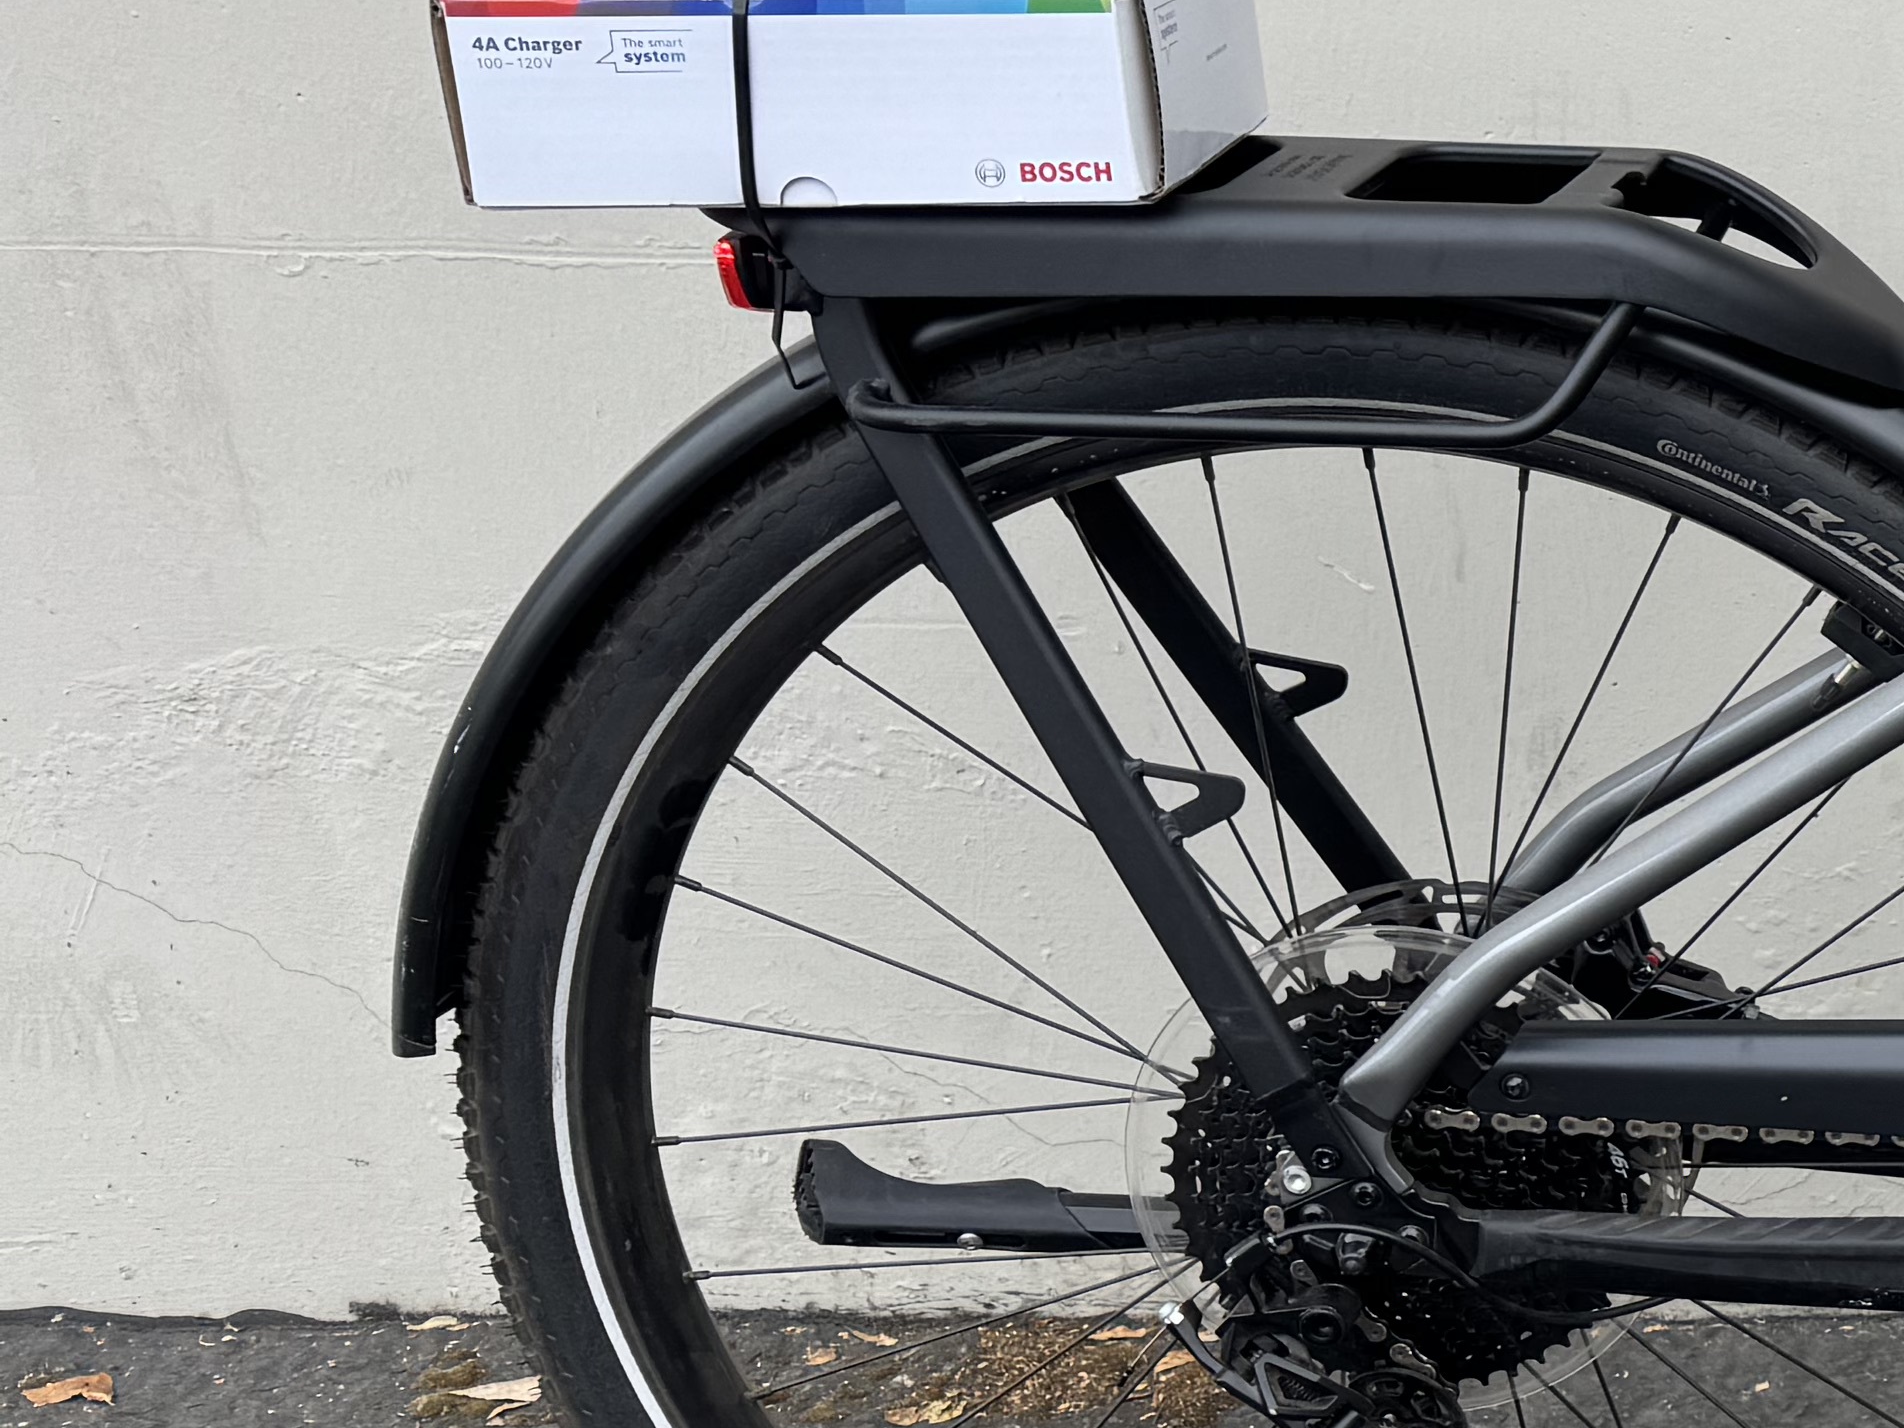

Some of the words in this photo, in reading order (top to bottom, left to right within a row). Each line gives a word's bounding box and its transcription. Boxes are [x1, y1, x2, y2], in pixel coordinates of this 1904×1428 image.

[472, 36, 499, 52] 4A
[504, 36, 583, 54] Charger
[621, 37, 644, 49] The
[648, 38, 684, 49] smart
[623, 51, 686, 65] system
[1019, 161, 1113, 183] BOSCH
[1656, 438, 1757, 492] Continental
[1607, 1142, 1629, 1179] 46T
